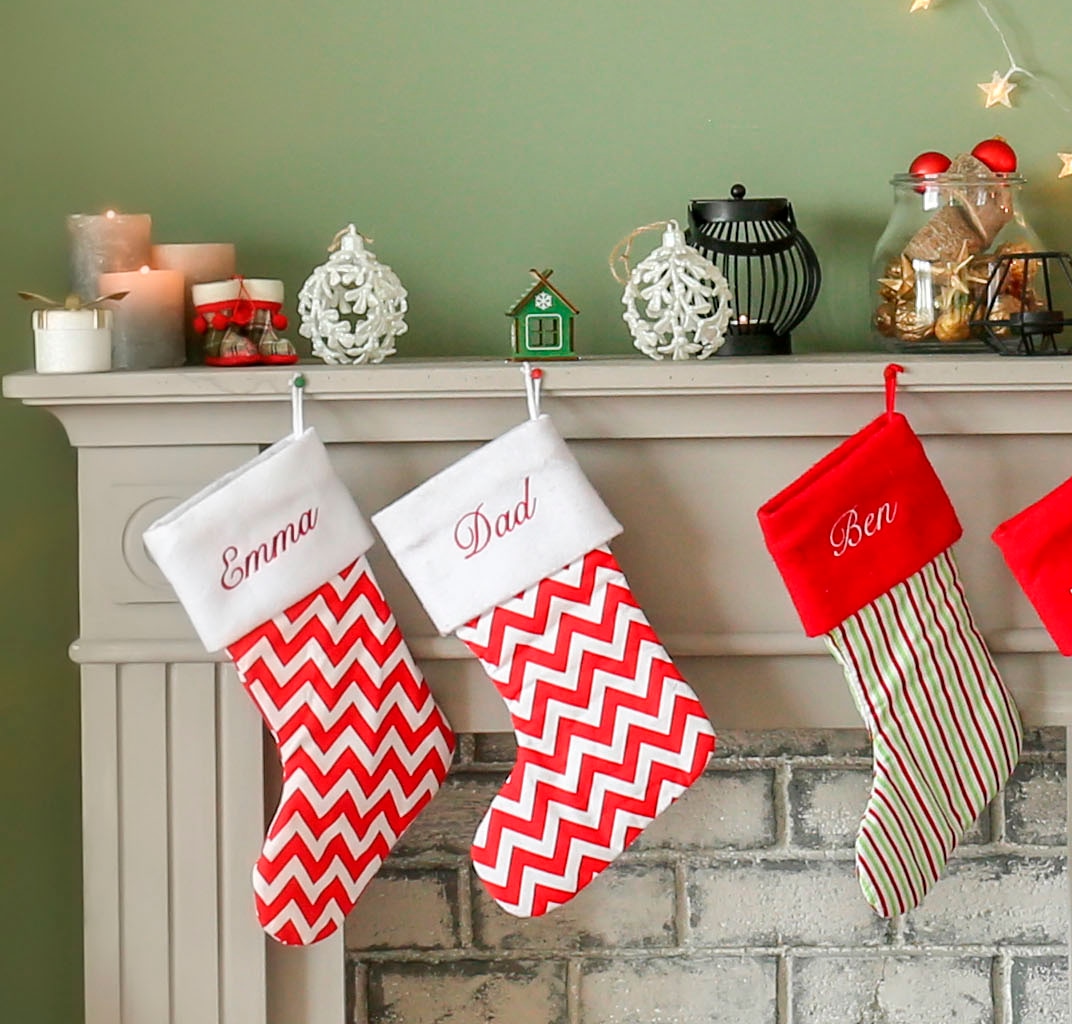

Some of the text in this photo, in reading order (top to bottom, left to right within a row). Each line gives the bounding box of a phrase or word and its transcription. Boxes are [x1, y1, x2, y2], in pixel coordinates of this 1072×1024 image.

[219, 505, 321, 591] Emma
[453, 476, 537, 561] Dad
[828, 500, 898, 558] Ben
